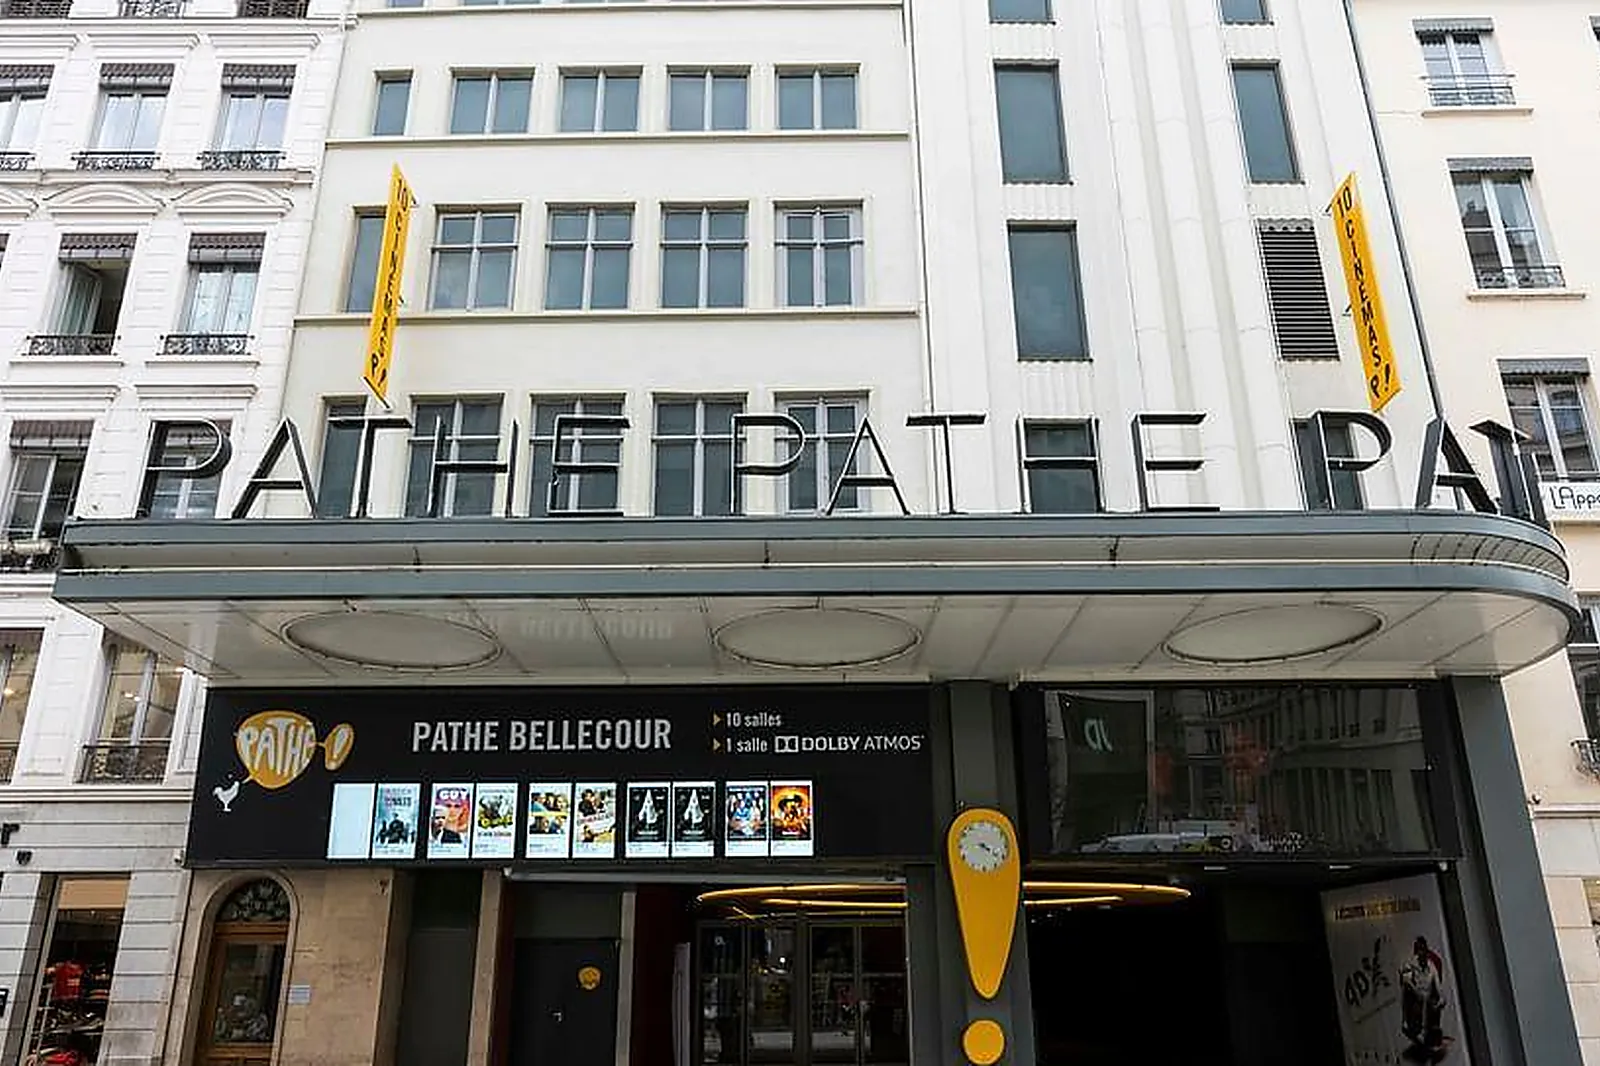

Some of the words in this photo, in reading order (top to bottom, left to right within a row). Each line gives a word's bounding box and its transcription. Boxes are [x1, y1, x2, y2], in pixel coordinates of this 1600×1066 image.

[1336, 186, 1352, 218] 10
[1346, 219, 1381, 367] CINEMAS
[136, 414, 630, 519] PATHE
[730, 413, 1220, 517] PATHE
[726, 712, 741, 727] 10
[744, 712, 782, 727] salles
[412, 721, 499, 752] PATHE
[509, 719, 672, 751] BELLECOUR
[726, 737, 733, 752] 1
[736, 737, 768, 752] salle
[801, 736, 860, 751] DOLBY
[864, 735, 921, 750] ATMOS
[438, 789, 468, 800] GUY
